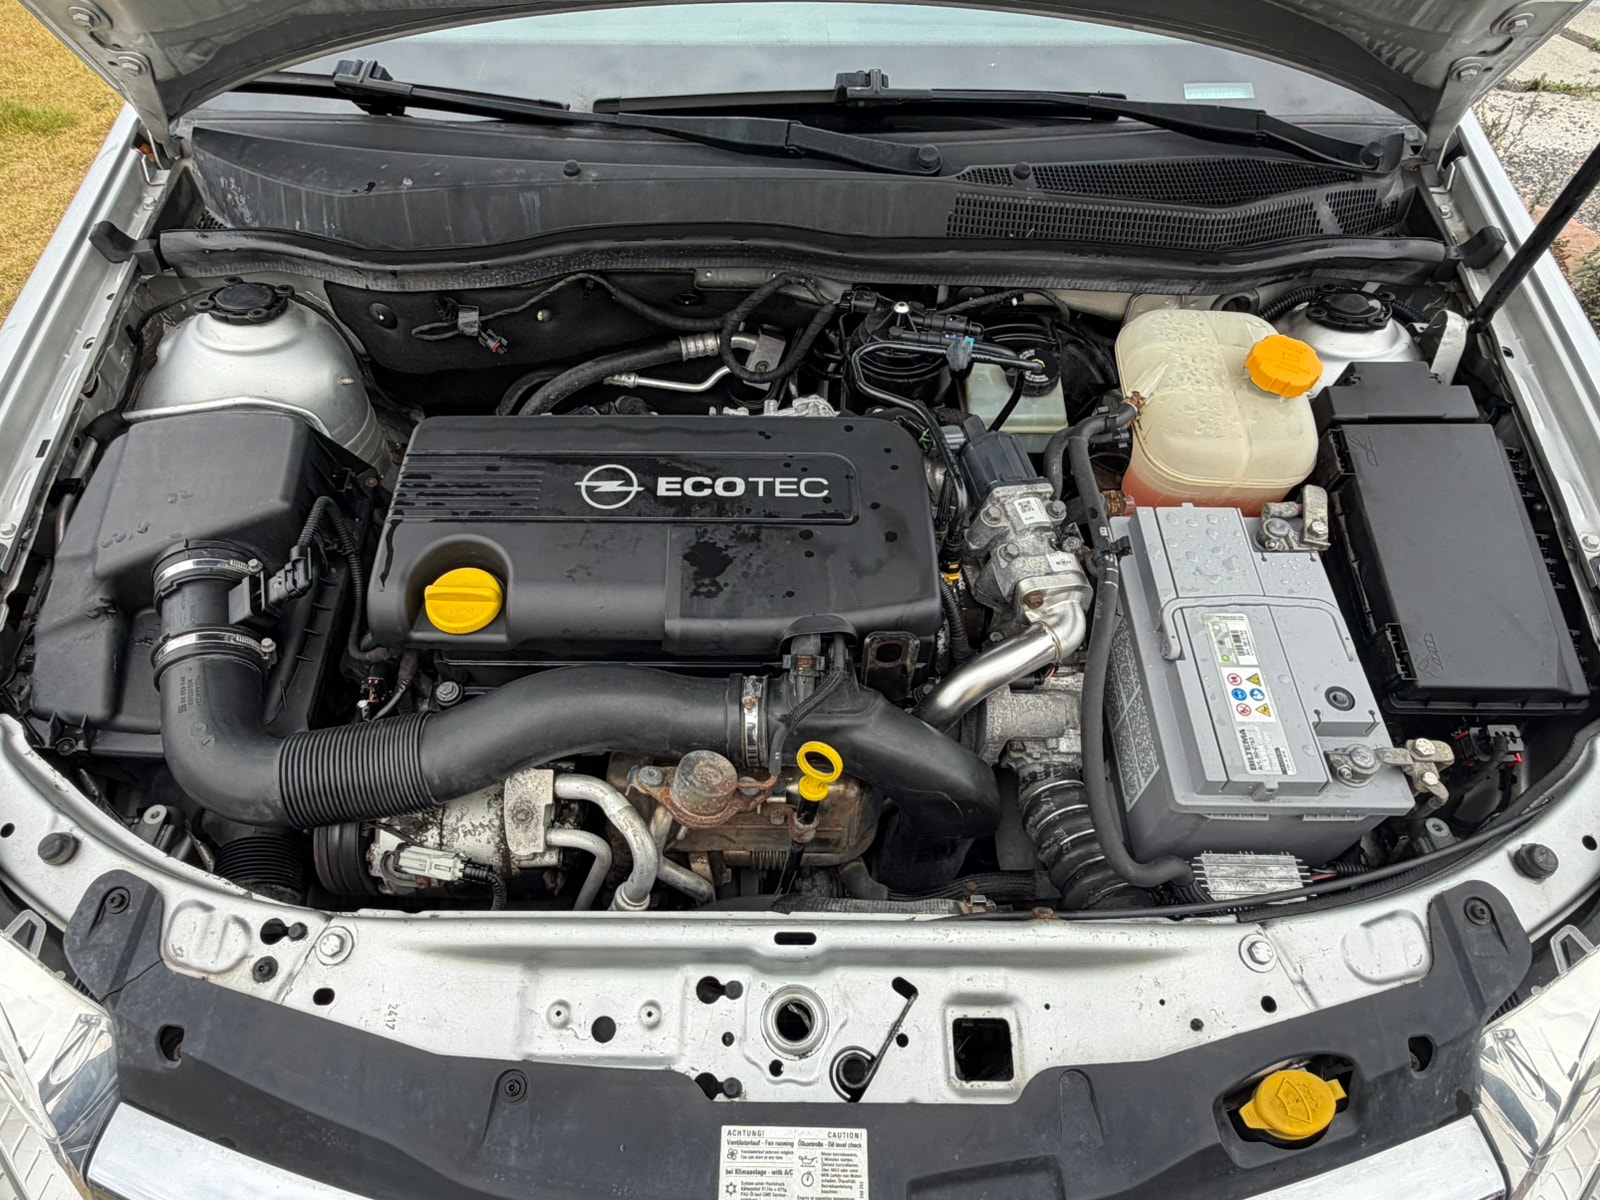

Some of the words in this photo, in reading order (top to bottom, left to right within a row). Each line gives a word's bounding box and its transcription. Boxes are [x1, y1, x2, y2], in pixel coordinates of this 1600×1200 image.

[656, 476, 830, 498] ECOTEC
[1239, 728, 1257, 771] BILTEMA
[385, 1003, 399, 1030] 2417
[727, 1129, 765, 1137] ACHTUNG!
[827, 1131, 863, 1140] CAUTION!
[775, 1141, 795, 1149] running
[735, 1168, 767, 1177] Klimaanlage
[784, 1168, 794, 1176] A/C
